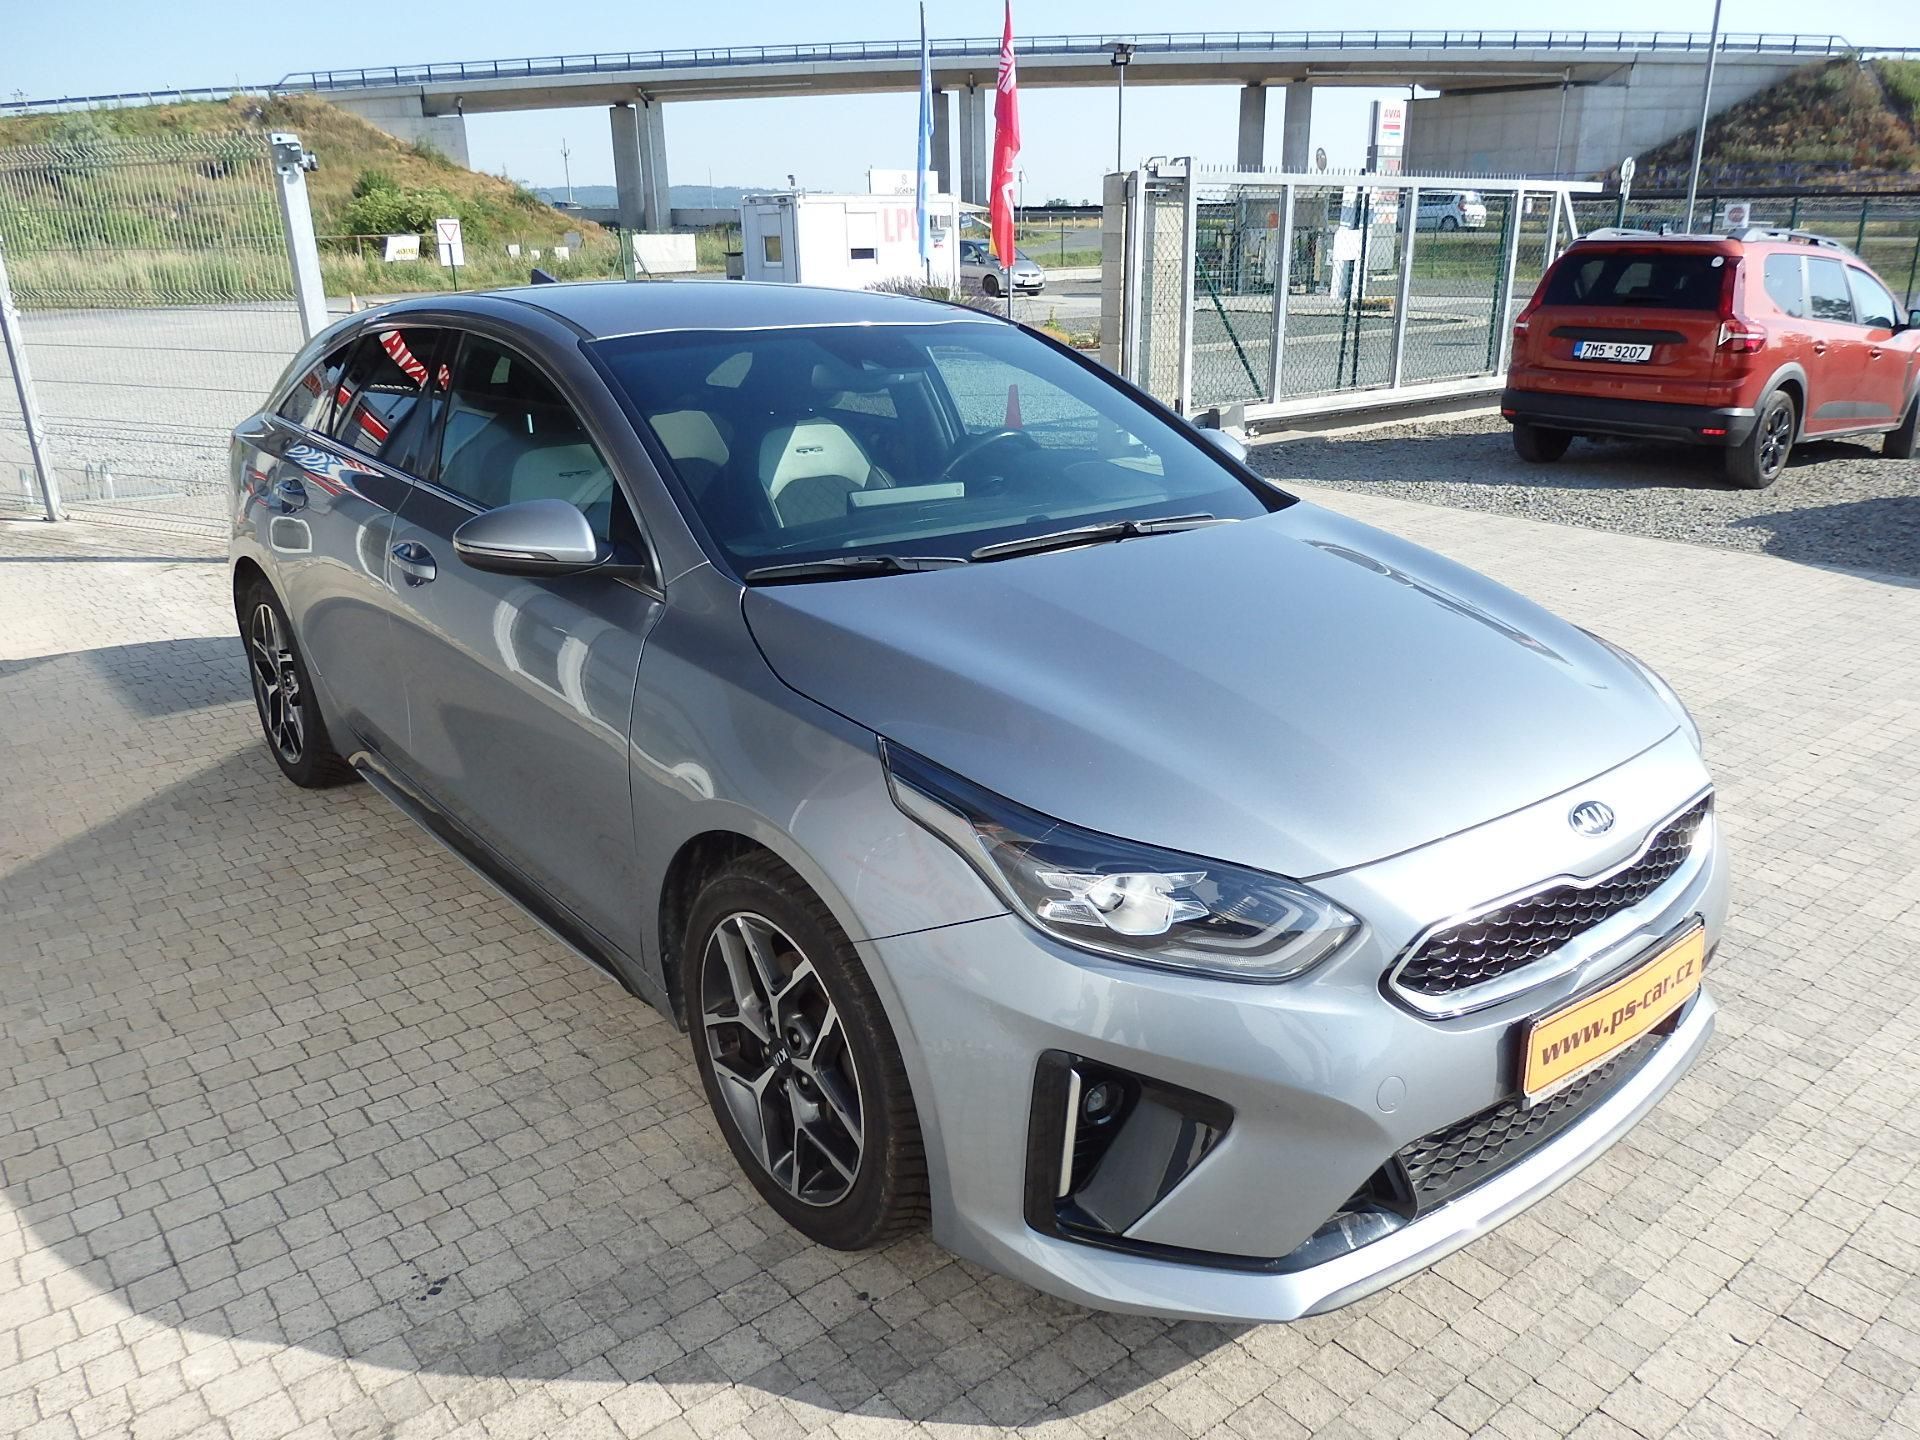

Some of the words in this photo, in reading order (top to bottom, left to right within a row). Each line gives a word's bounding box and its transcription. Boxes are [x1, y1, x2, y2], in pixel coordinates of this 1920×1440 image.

[1583, 343, 1607, 356] 7M5
[1614, 345, 1646, 359] 9207
[1574, 802, 1614, 831] KIA
[1541, 958, 1695, 1066] www.ps-car.cz
[773, 1047, 789, 1067] KIA
